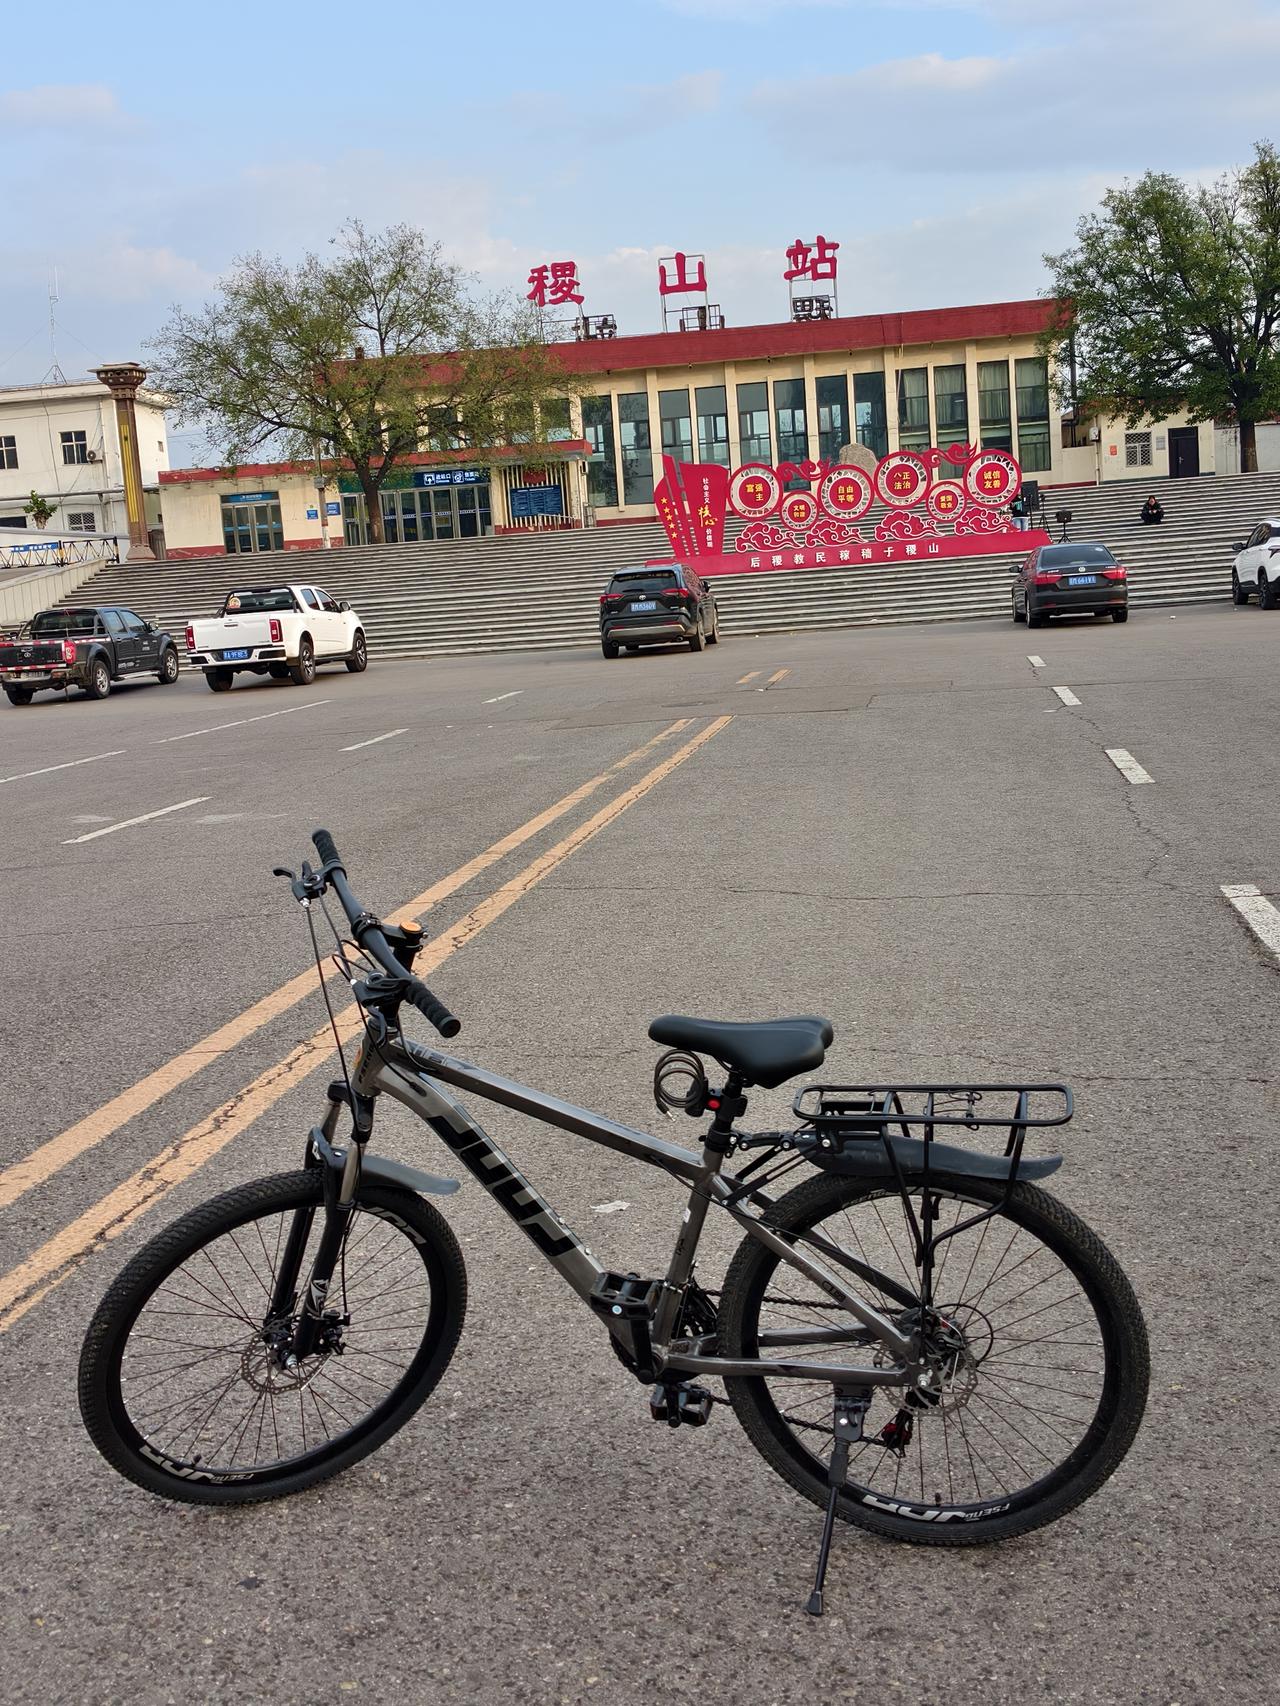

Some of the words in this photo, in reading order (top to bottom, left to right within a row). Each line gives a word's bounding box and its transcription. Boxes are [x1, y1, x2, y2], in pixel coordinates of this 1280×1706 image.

[527, 235, 840, 307] 稷山站
[983, 470, 1001, 480] 诚信
[746, 483, 763, 493] 富强
[893, 480, 911, 490] 法治
[983, 479, 1001, 489] 友善
[838, 485, 854, 494] 自由
[838, 494, 854, 503] 平等
